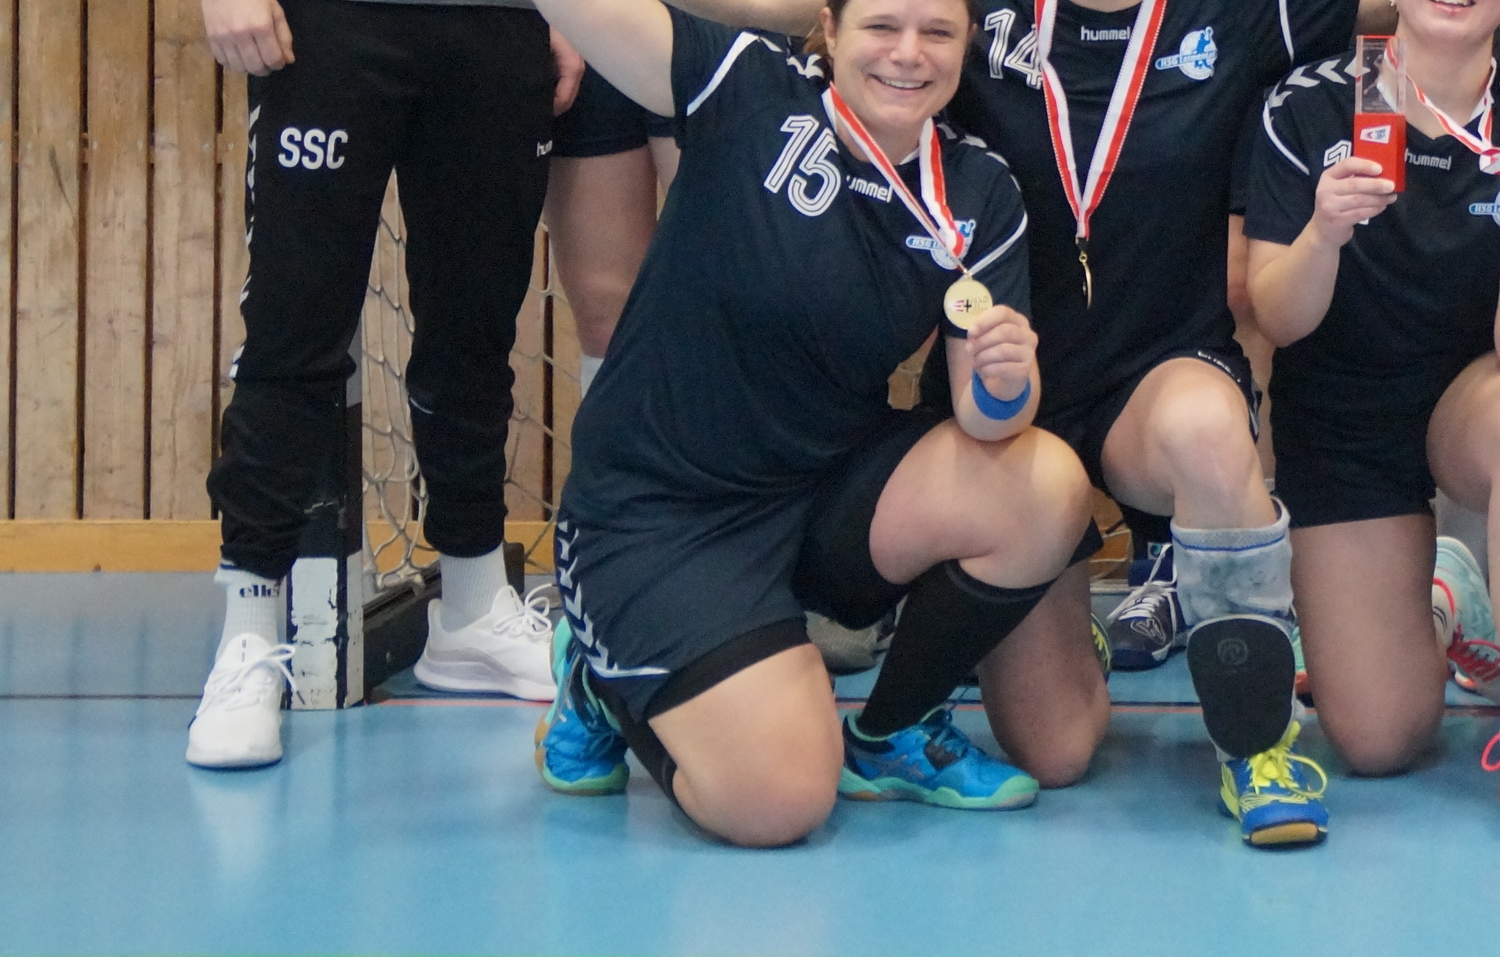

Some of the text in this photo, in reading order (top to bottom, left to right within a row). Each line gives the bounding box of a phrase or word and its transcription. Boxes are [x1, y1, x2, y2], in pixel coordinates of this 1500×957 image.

[984, 8, 1043, 90] 14
[1081, 26, 1131, 42] hummel
[278, 126, 348, 170] SSC
[764, 115, 841, 217] 15
[1405, 148, 1451, 171] hummel
[846, 175, 892, 203] ummel
